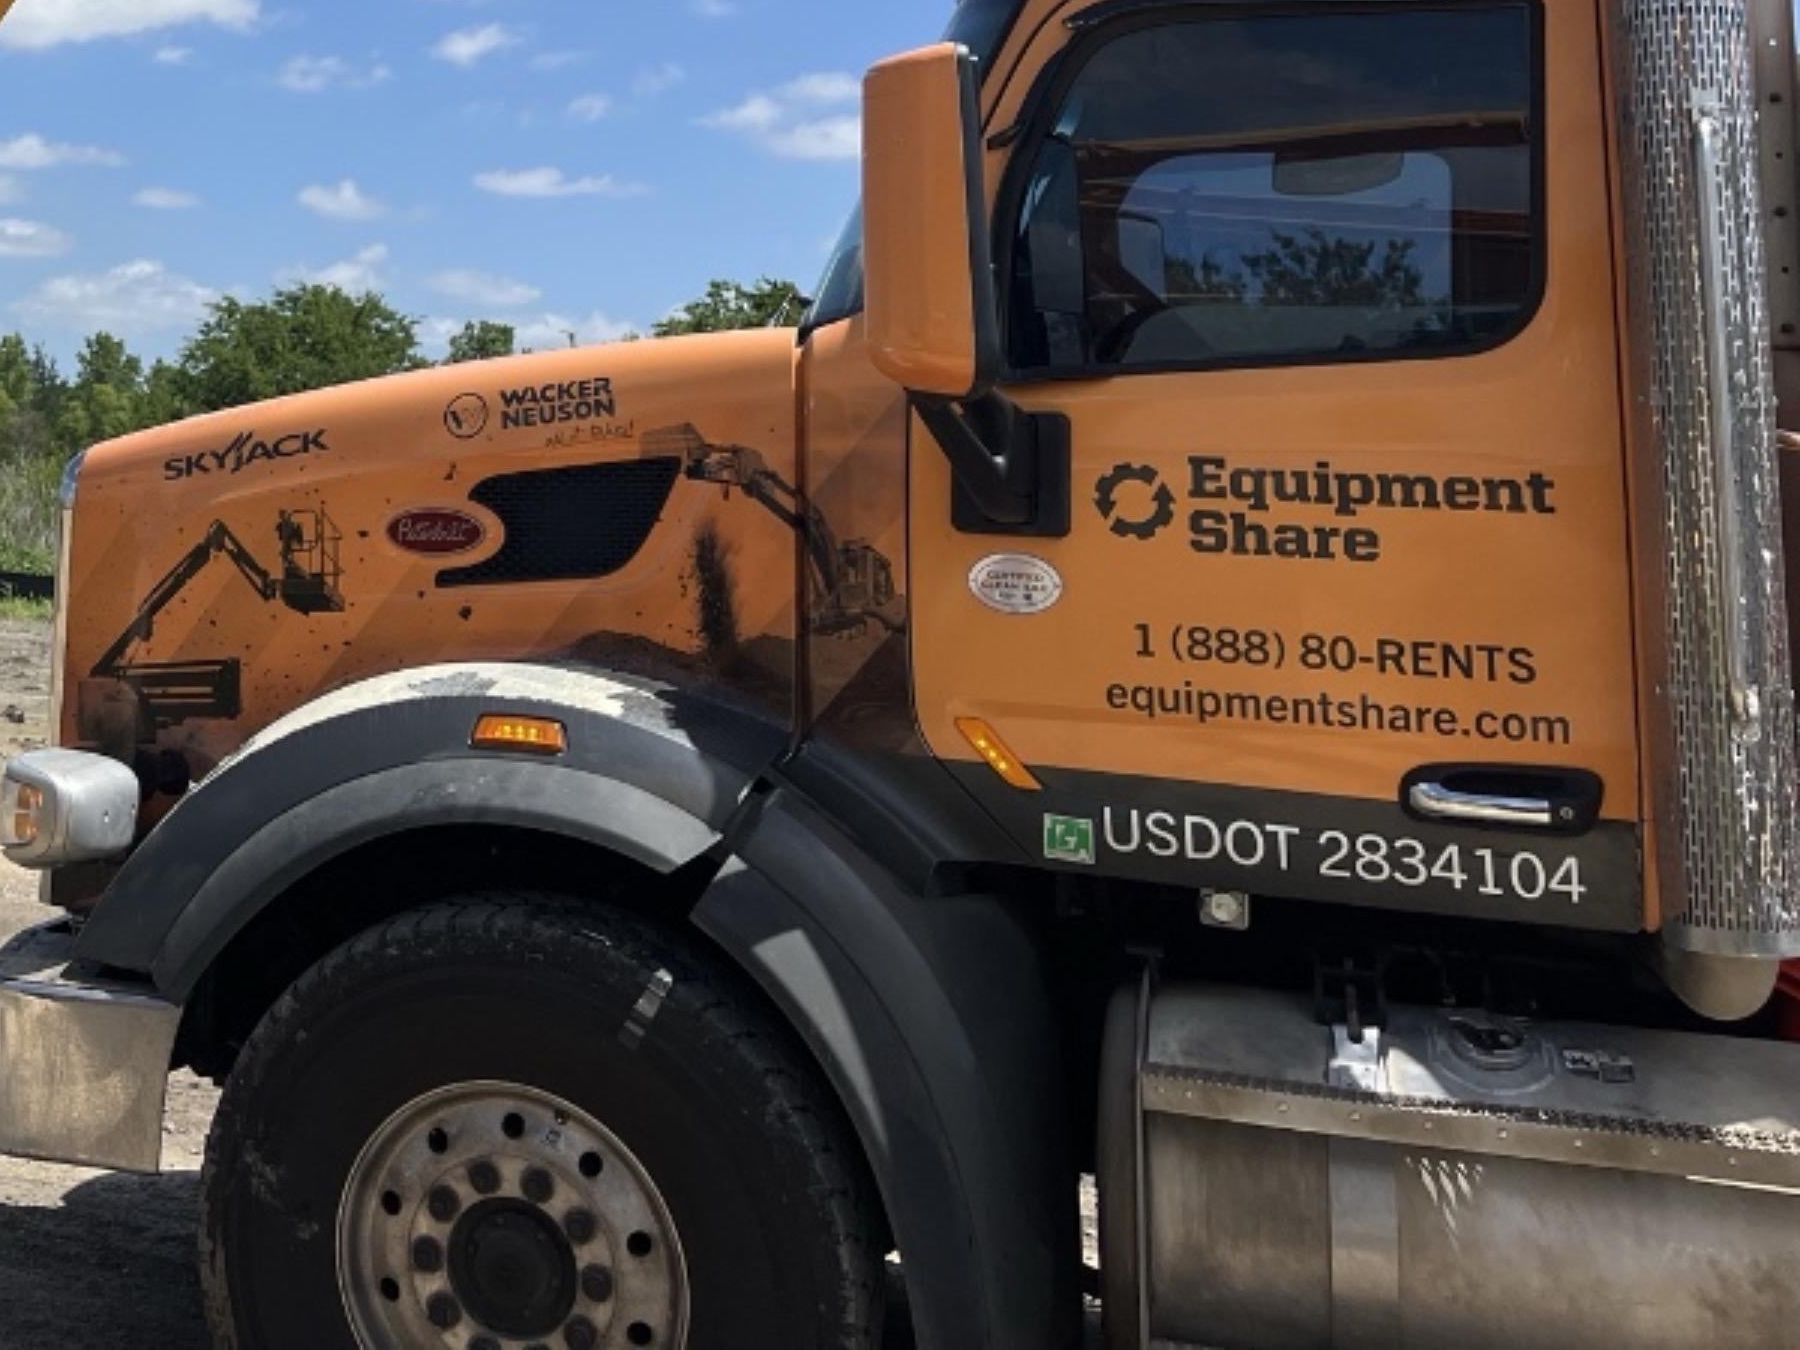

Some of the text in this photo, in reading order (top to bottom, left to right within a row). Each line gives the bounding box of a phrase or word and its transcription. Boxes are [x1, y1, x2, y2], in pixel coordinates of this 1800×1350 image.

[500, 377, 613, 408] WACKER
[501, 398, 616, 430] NEUSON
[163, 428, 329, 481] SKYJACK
[1187, 456, 1556, 515] Equipment
[1188, 511, 1380, 562] Share
[1133, 623, 1538, 685] 1 (888) 80-RENTS
[1105, 680, 1572, 745] equipmentshare.com
[1103, 805, 1587, 905] USDOT 2834104
